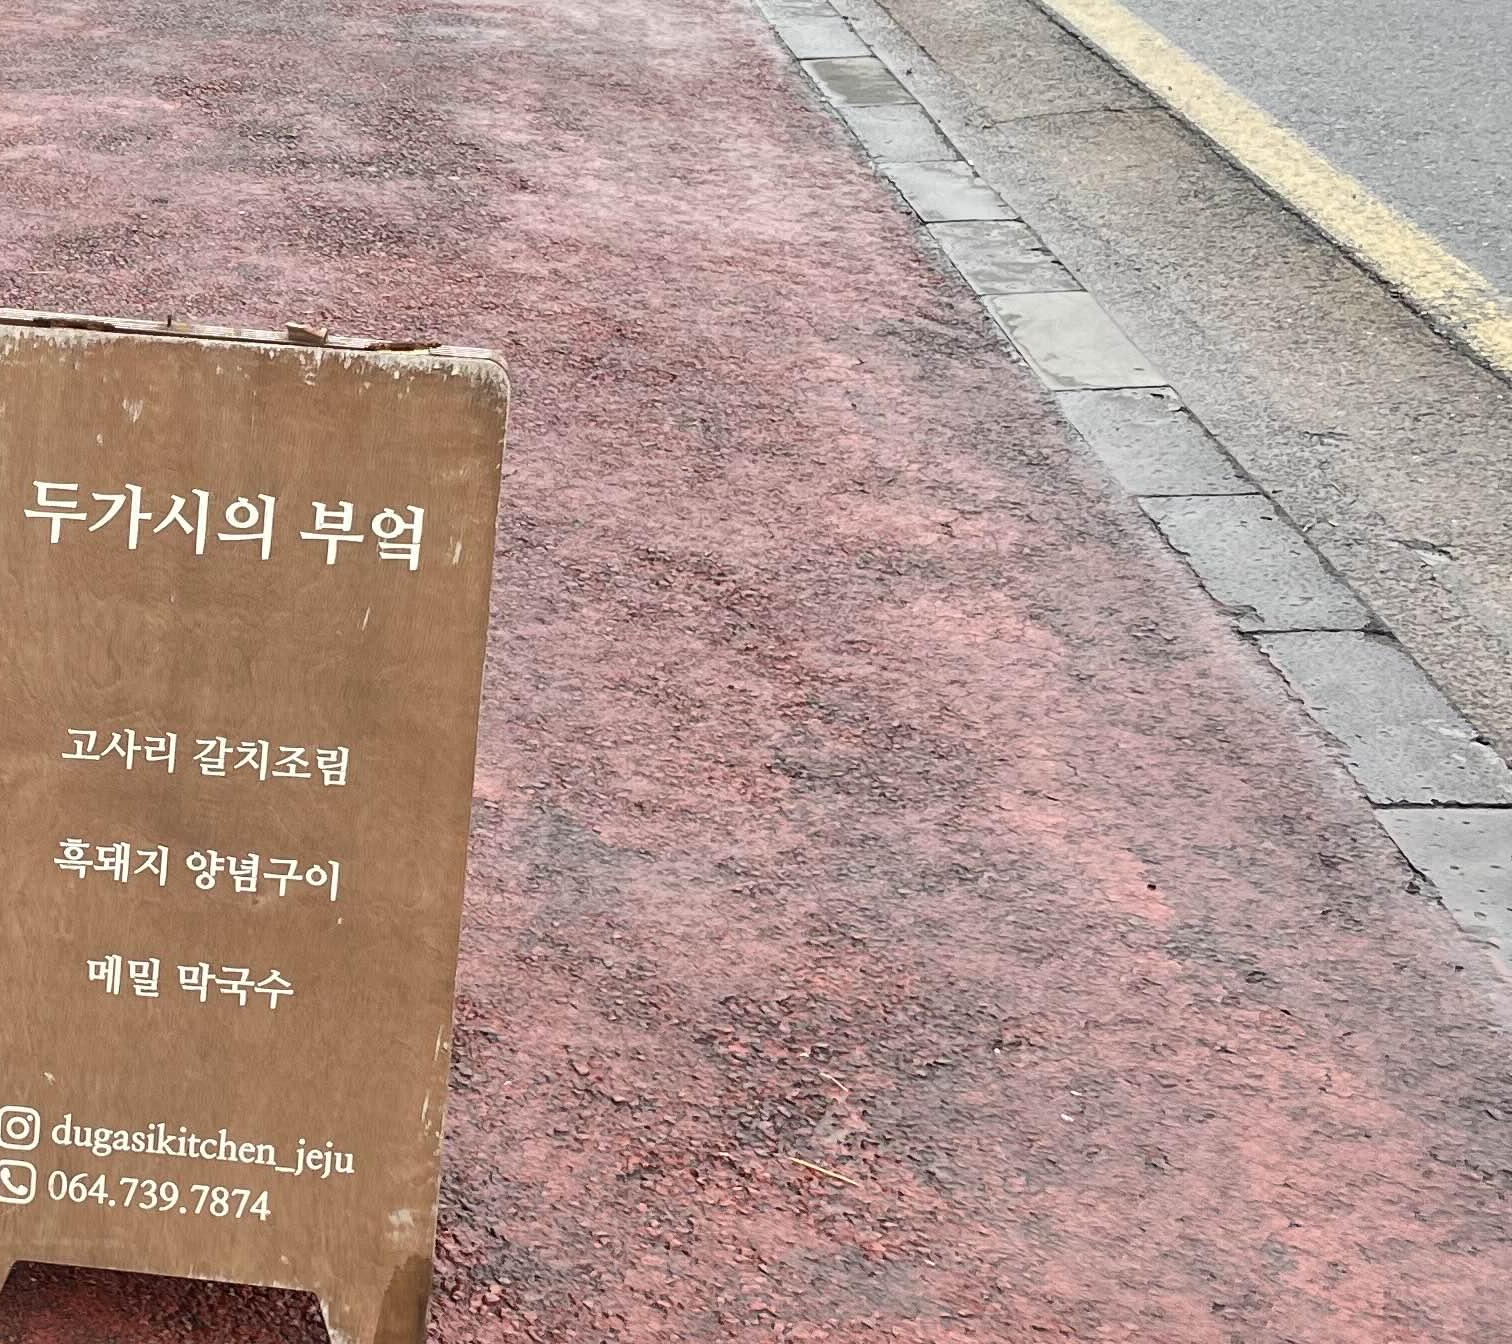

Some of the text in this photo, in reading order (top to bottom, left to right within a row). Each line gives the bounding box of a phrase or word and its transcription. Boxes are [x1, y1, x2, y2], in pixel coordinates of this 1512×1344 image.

[23, 480, 425, 571] 두가시의 부엌
[61, 728, 350, 786] 고사리 갈치조림
[53, 838, 341, 902] 흑돼지 양념구이
[86, 954, 295, 1009] 메밀 막국수
[51, 1113, 355, 1179] dugasikitchen_jeju
[47, 1170, 271, 1221] 064.739.7874
